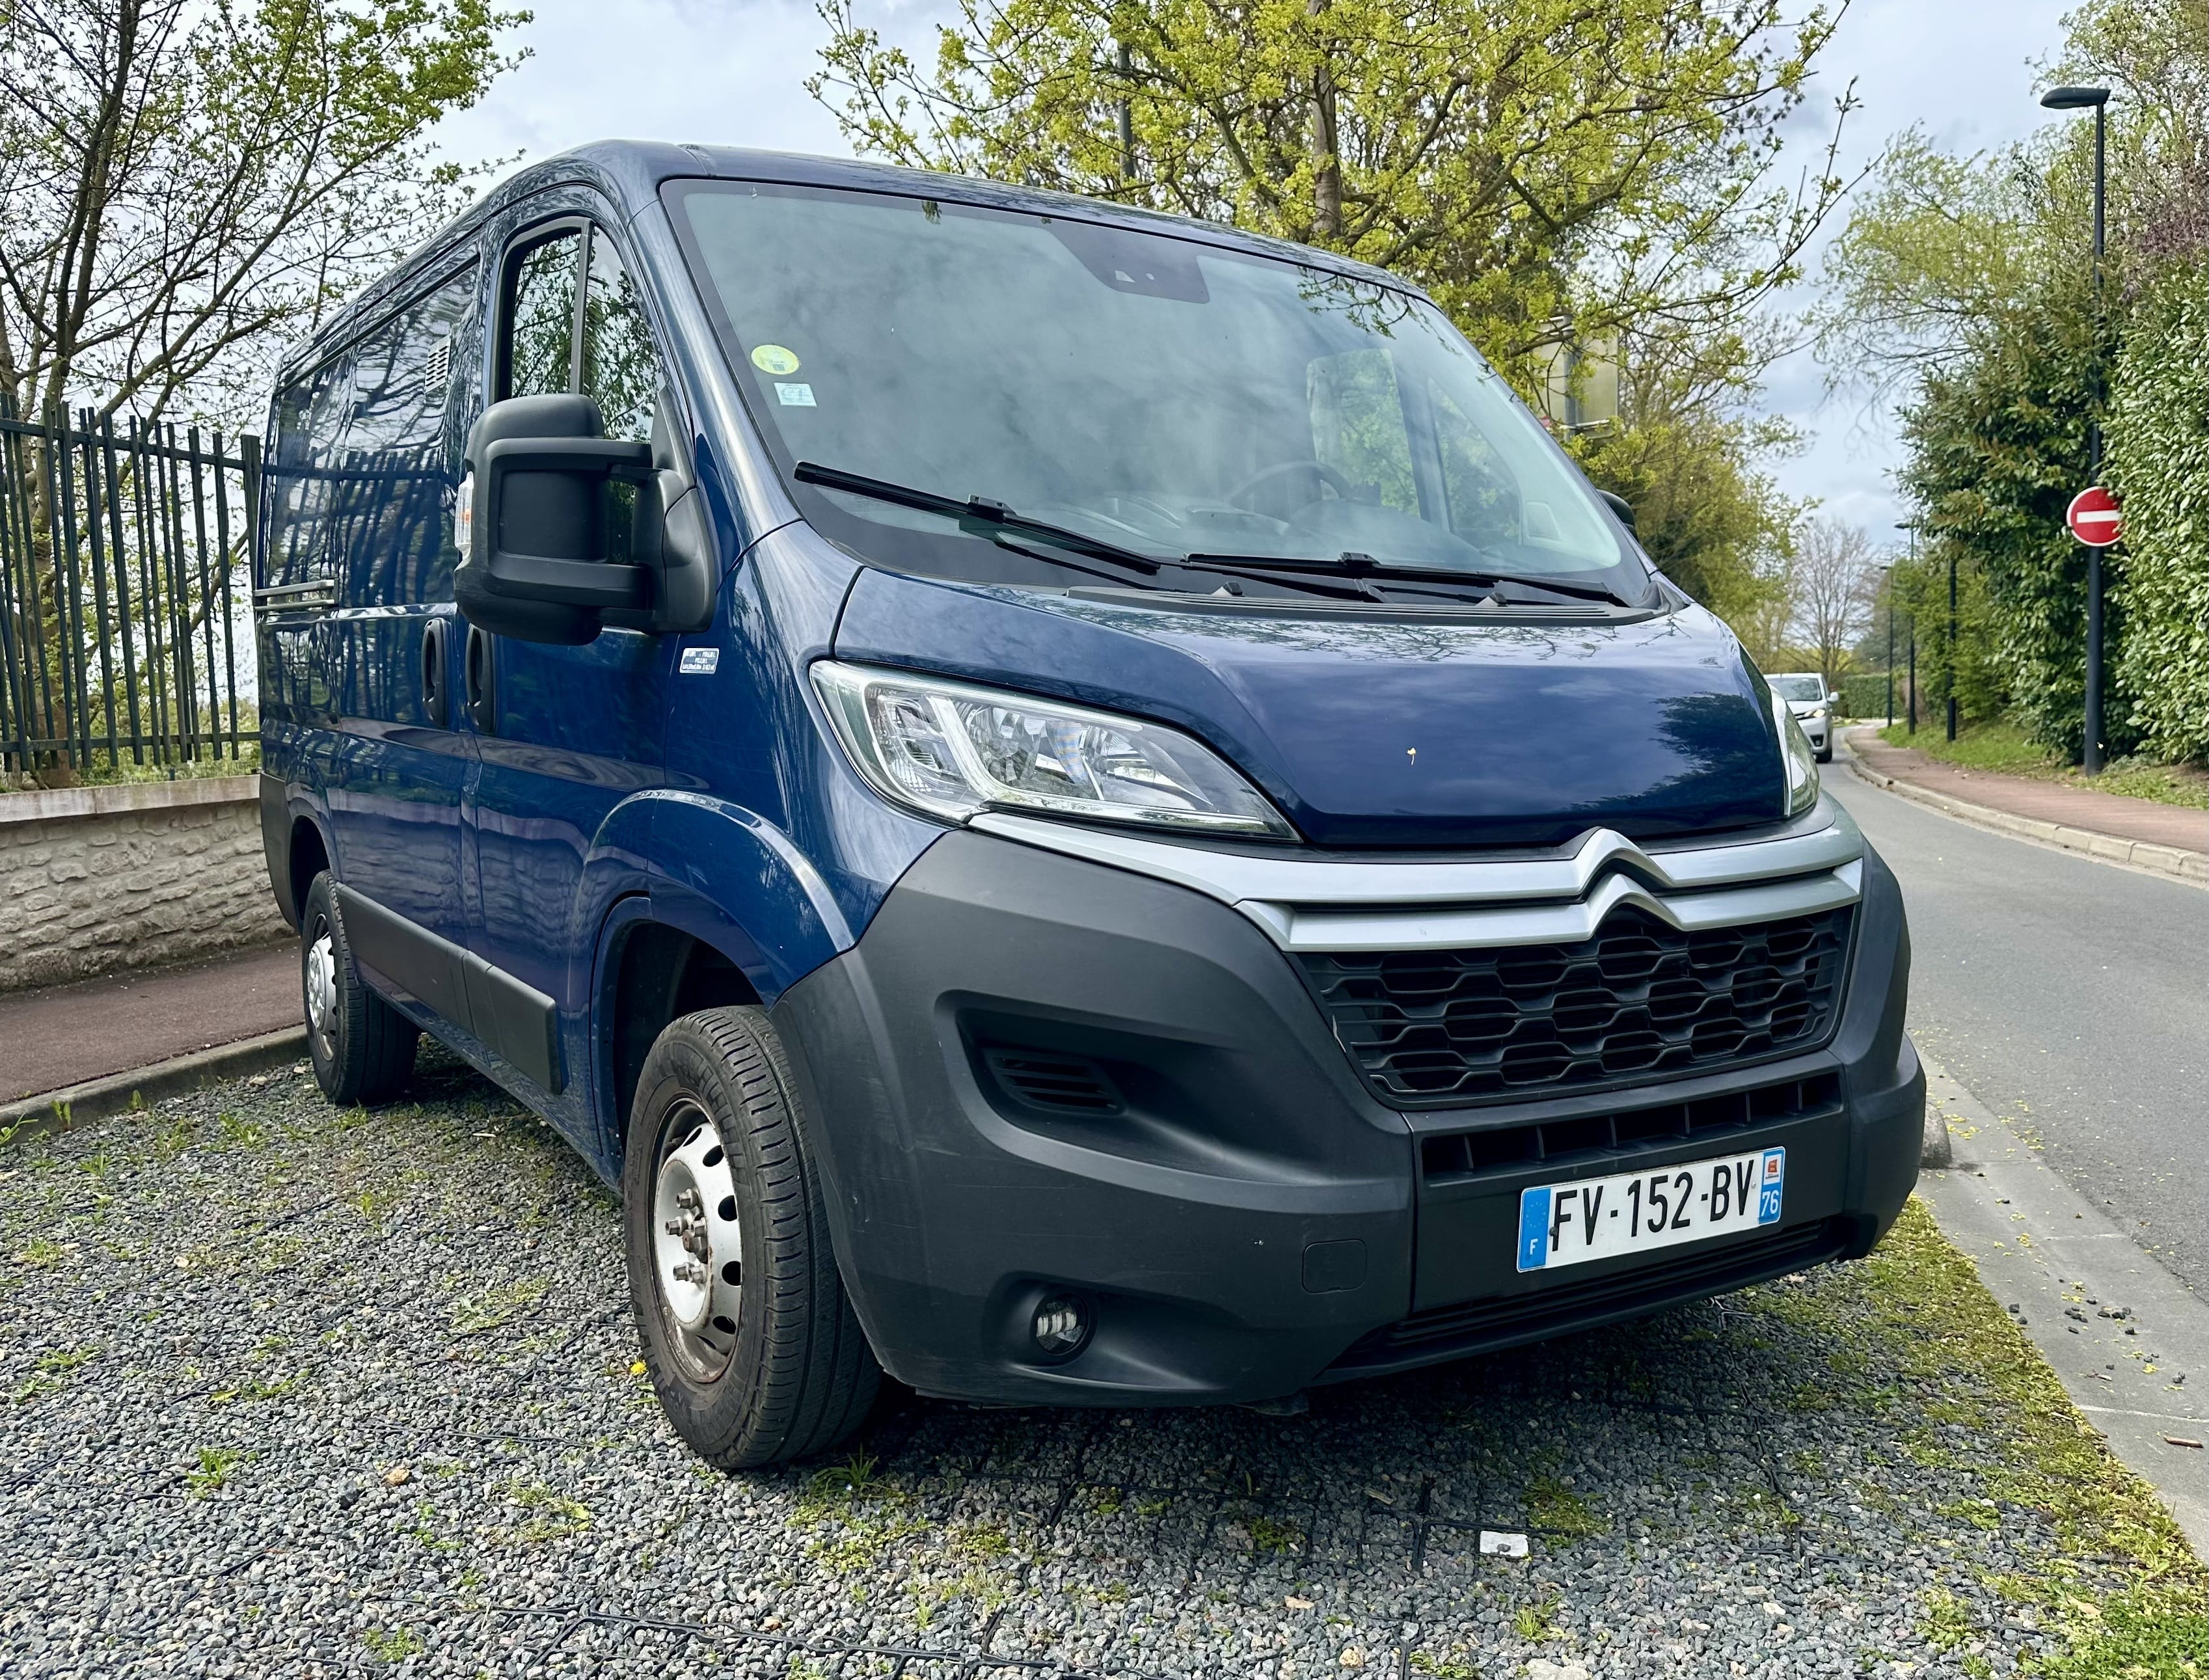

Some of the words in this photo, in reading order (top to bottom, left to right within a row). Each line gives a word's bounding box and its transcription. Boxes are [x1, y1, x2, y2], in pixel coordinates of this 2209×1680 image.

[1551, 1159, 1755, 1253] FV-152-BV
[1761, 1189, 1780, 1217] 76
[1529, 1238, 1539, 1255] F
